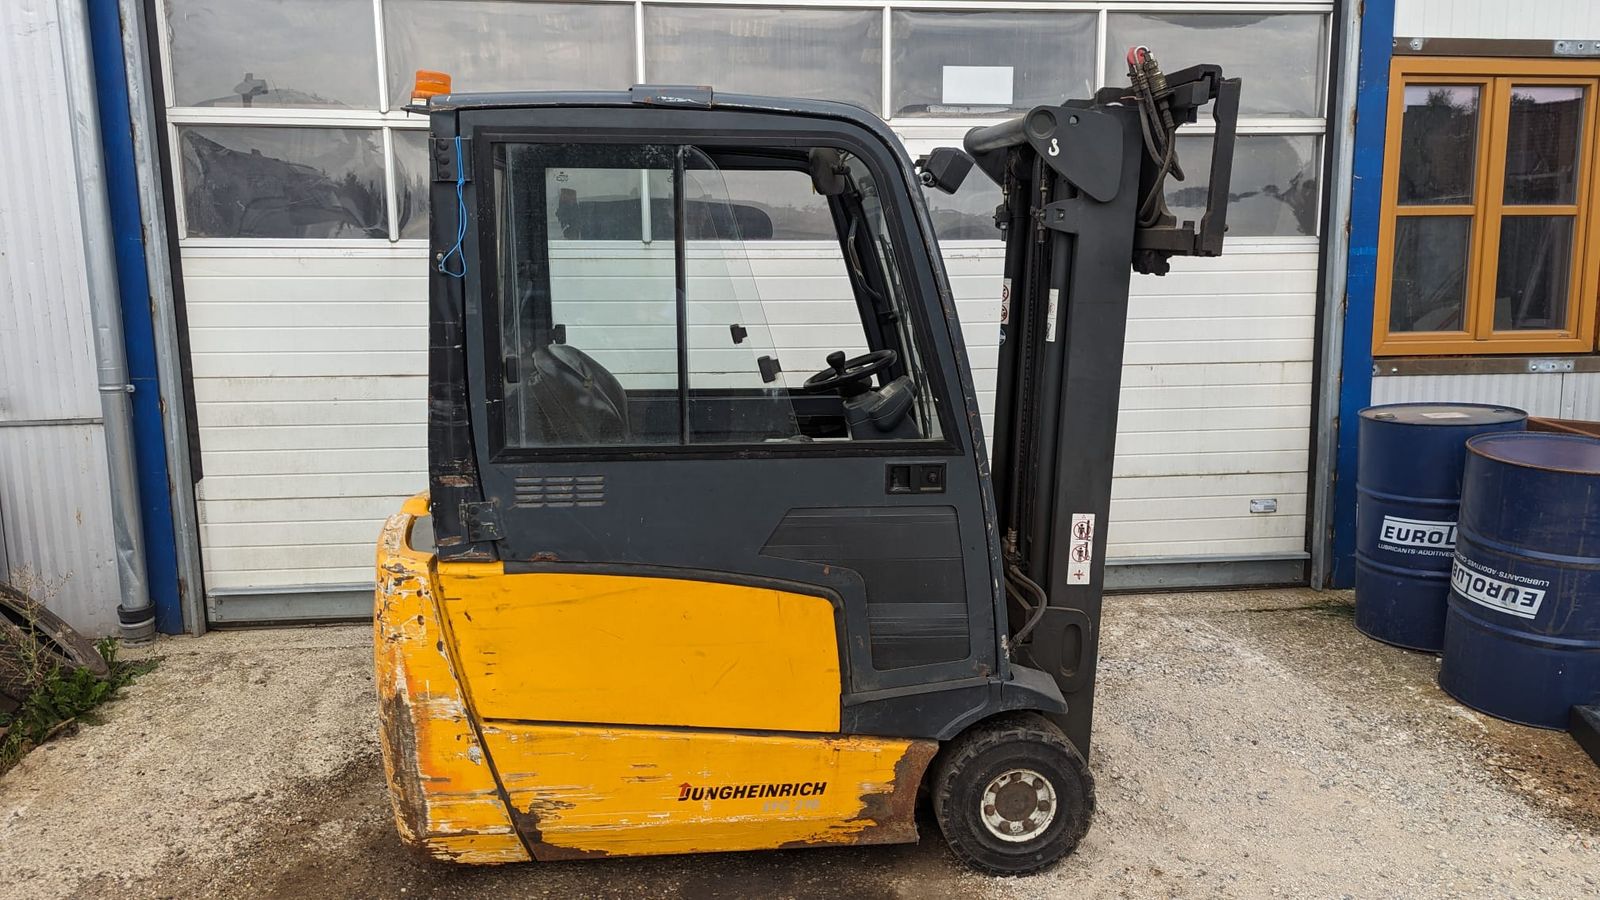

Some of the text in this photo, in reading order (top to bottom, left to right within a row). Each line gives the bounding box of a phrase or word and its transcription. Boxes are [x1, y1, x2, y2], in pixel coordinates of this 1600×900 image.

[1384, 525, 1456, 545] EUROL
[1378, 543, 1416, 554] LUBRICANTS
[1498, 571, 1550, 587] LUBRICANTS
[678, 781, 828, 802] JUNGHEINRICH
